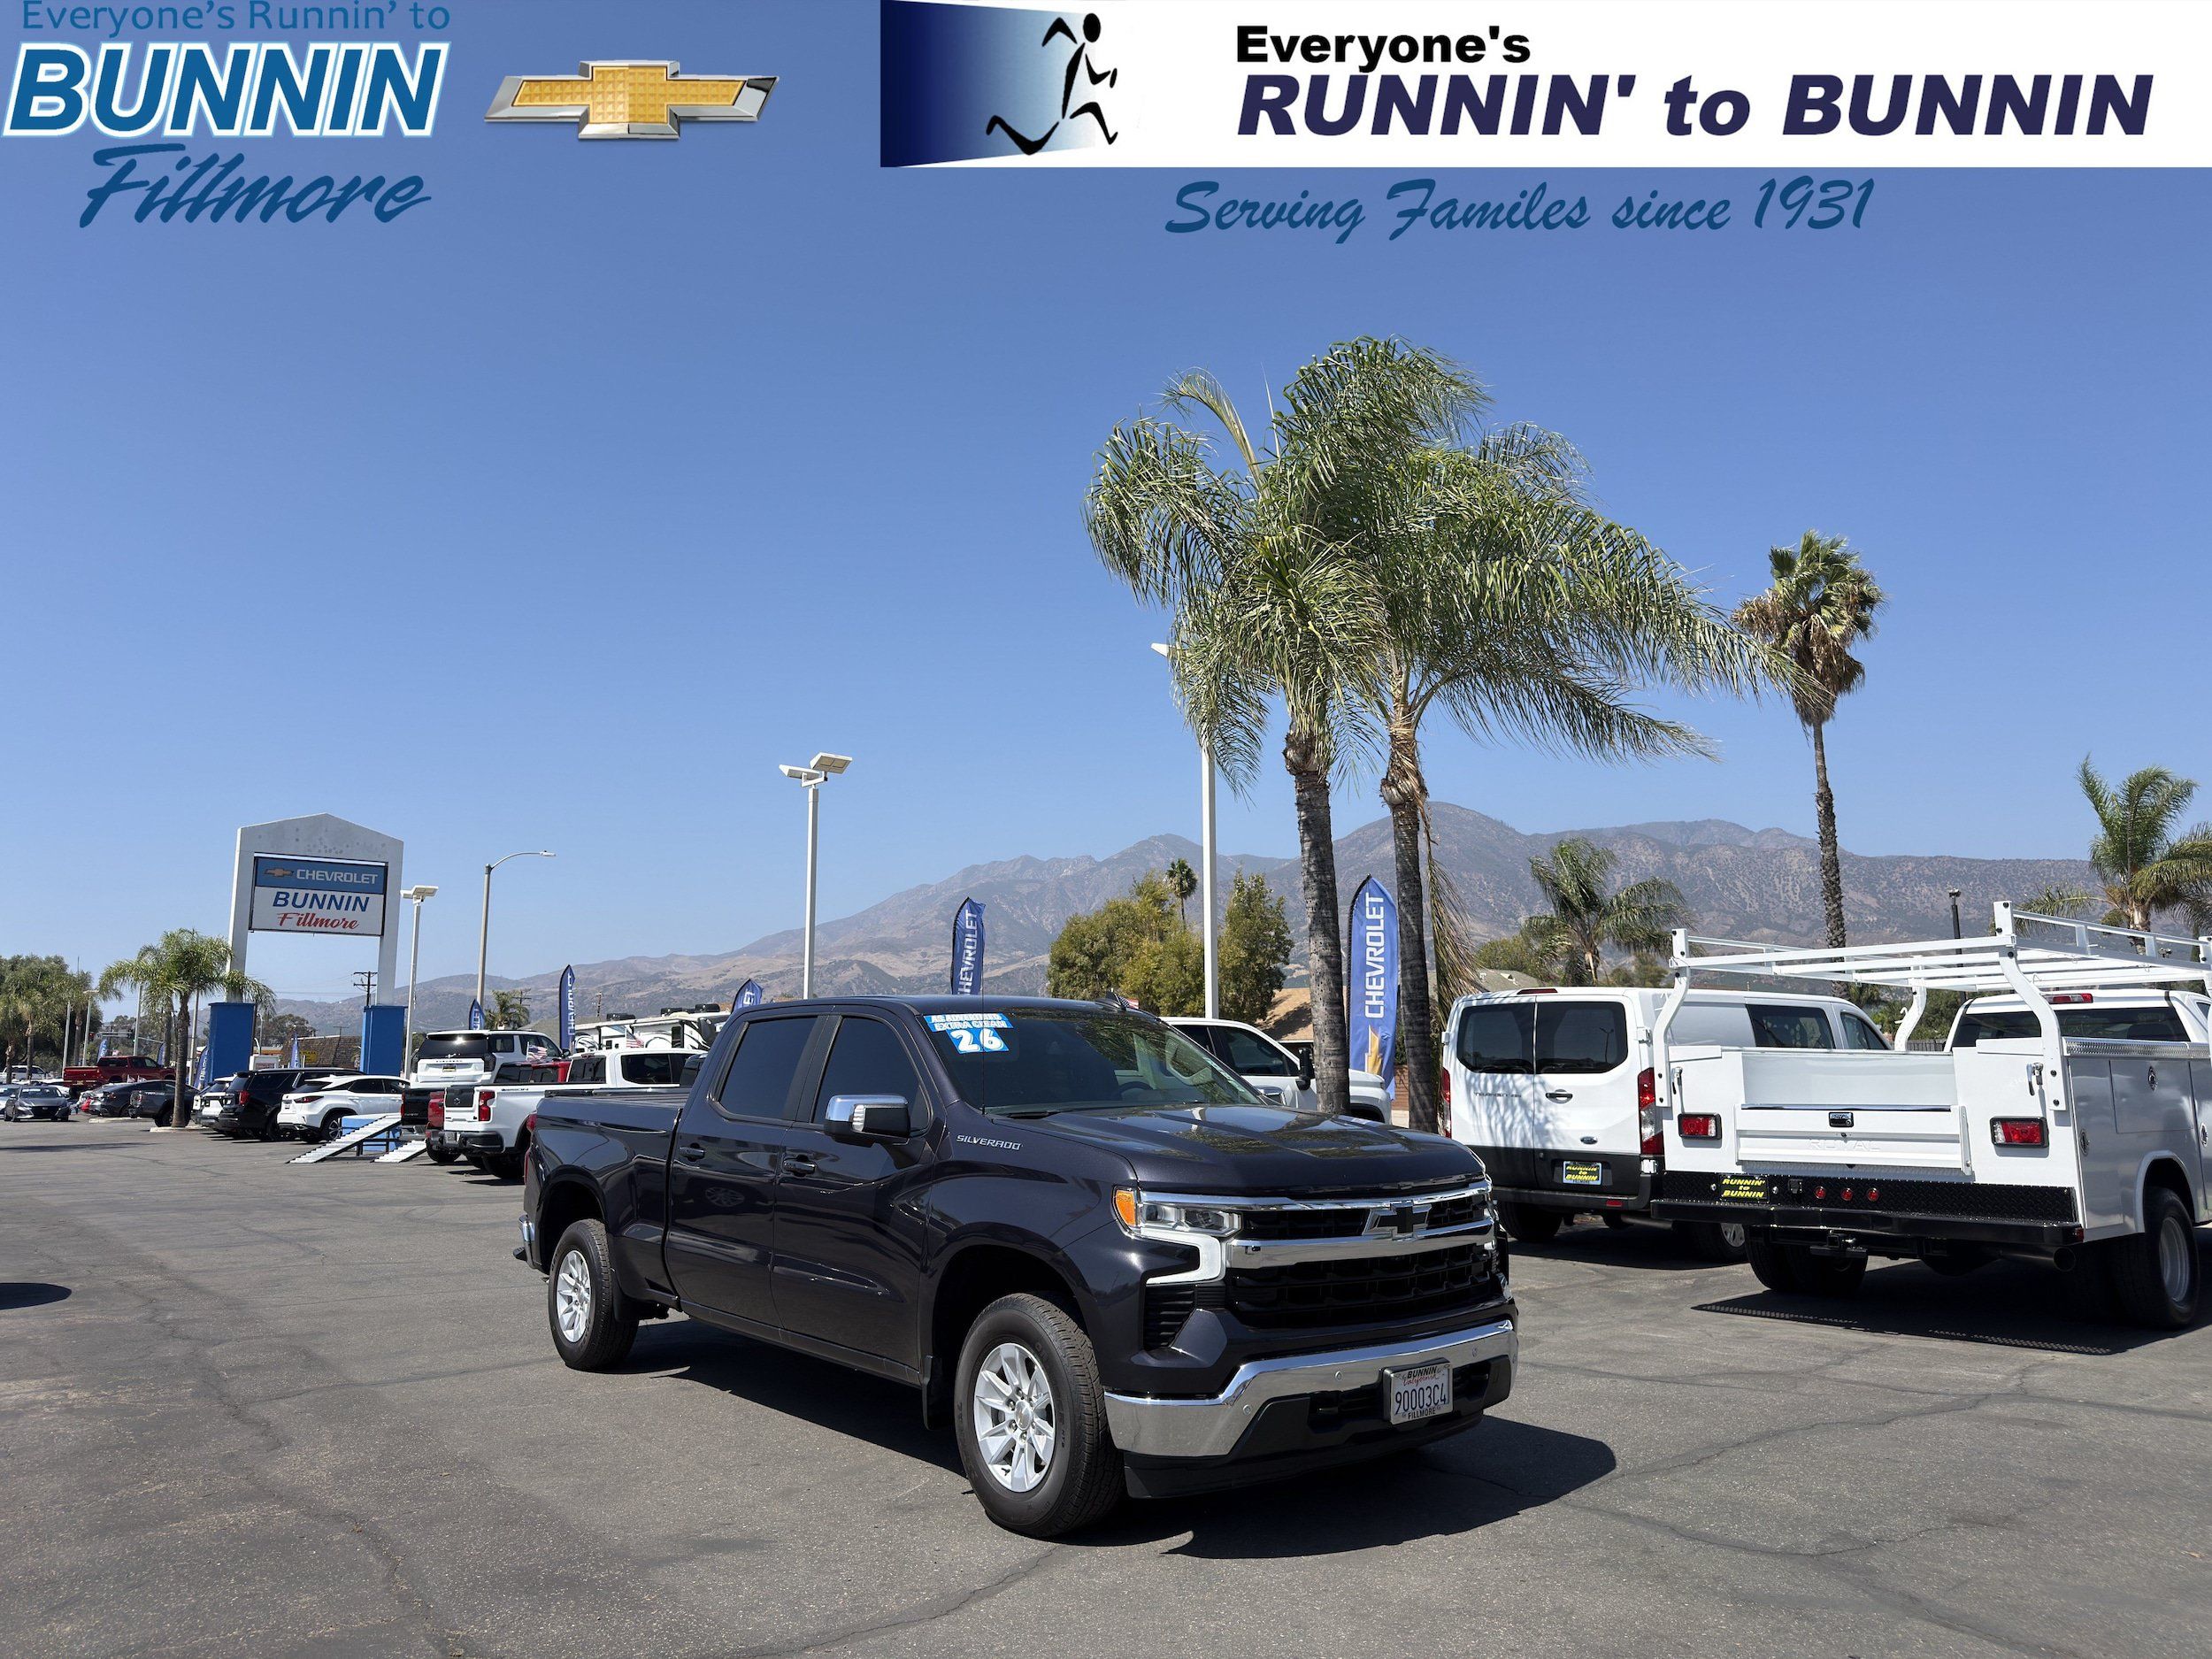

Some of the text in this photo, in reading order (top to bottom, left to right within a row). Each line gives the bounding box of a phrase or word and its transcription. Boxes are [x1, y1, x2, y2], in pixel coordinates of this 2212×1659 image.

[296, 869, 379, 885] CHEVROLET
[273, 891, 370, 912] BUNNIN
[277, 912, 360, 930] Fillmore
[957, 909, 978, 995] HEVROLET
[1363, 892, 1385, 1019] CHEVROLET
[949, 1027, 1004, 1053] 26
[956, 1134, 1022, 1150] SILVERADO
[1722, 1189, 1765, 1199] BUNNIN
[1407, 1365, 1438, 1379] BUNNIN
[1394, 1382, 1447, 1416] 90003C4
[1408, 1407, 1436, 1420] FILLMORE
